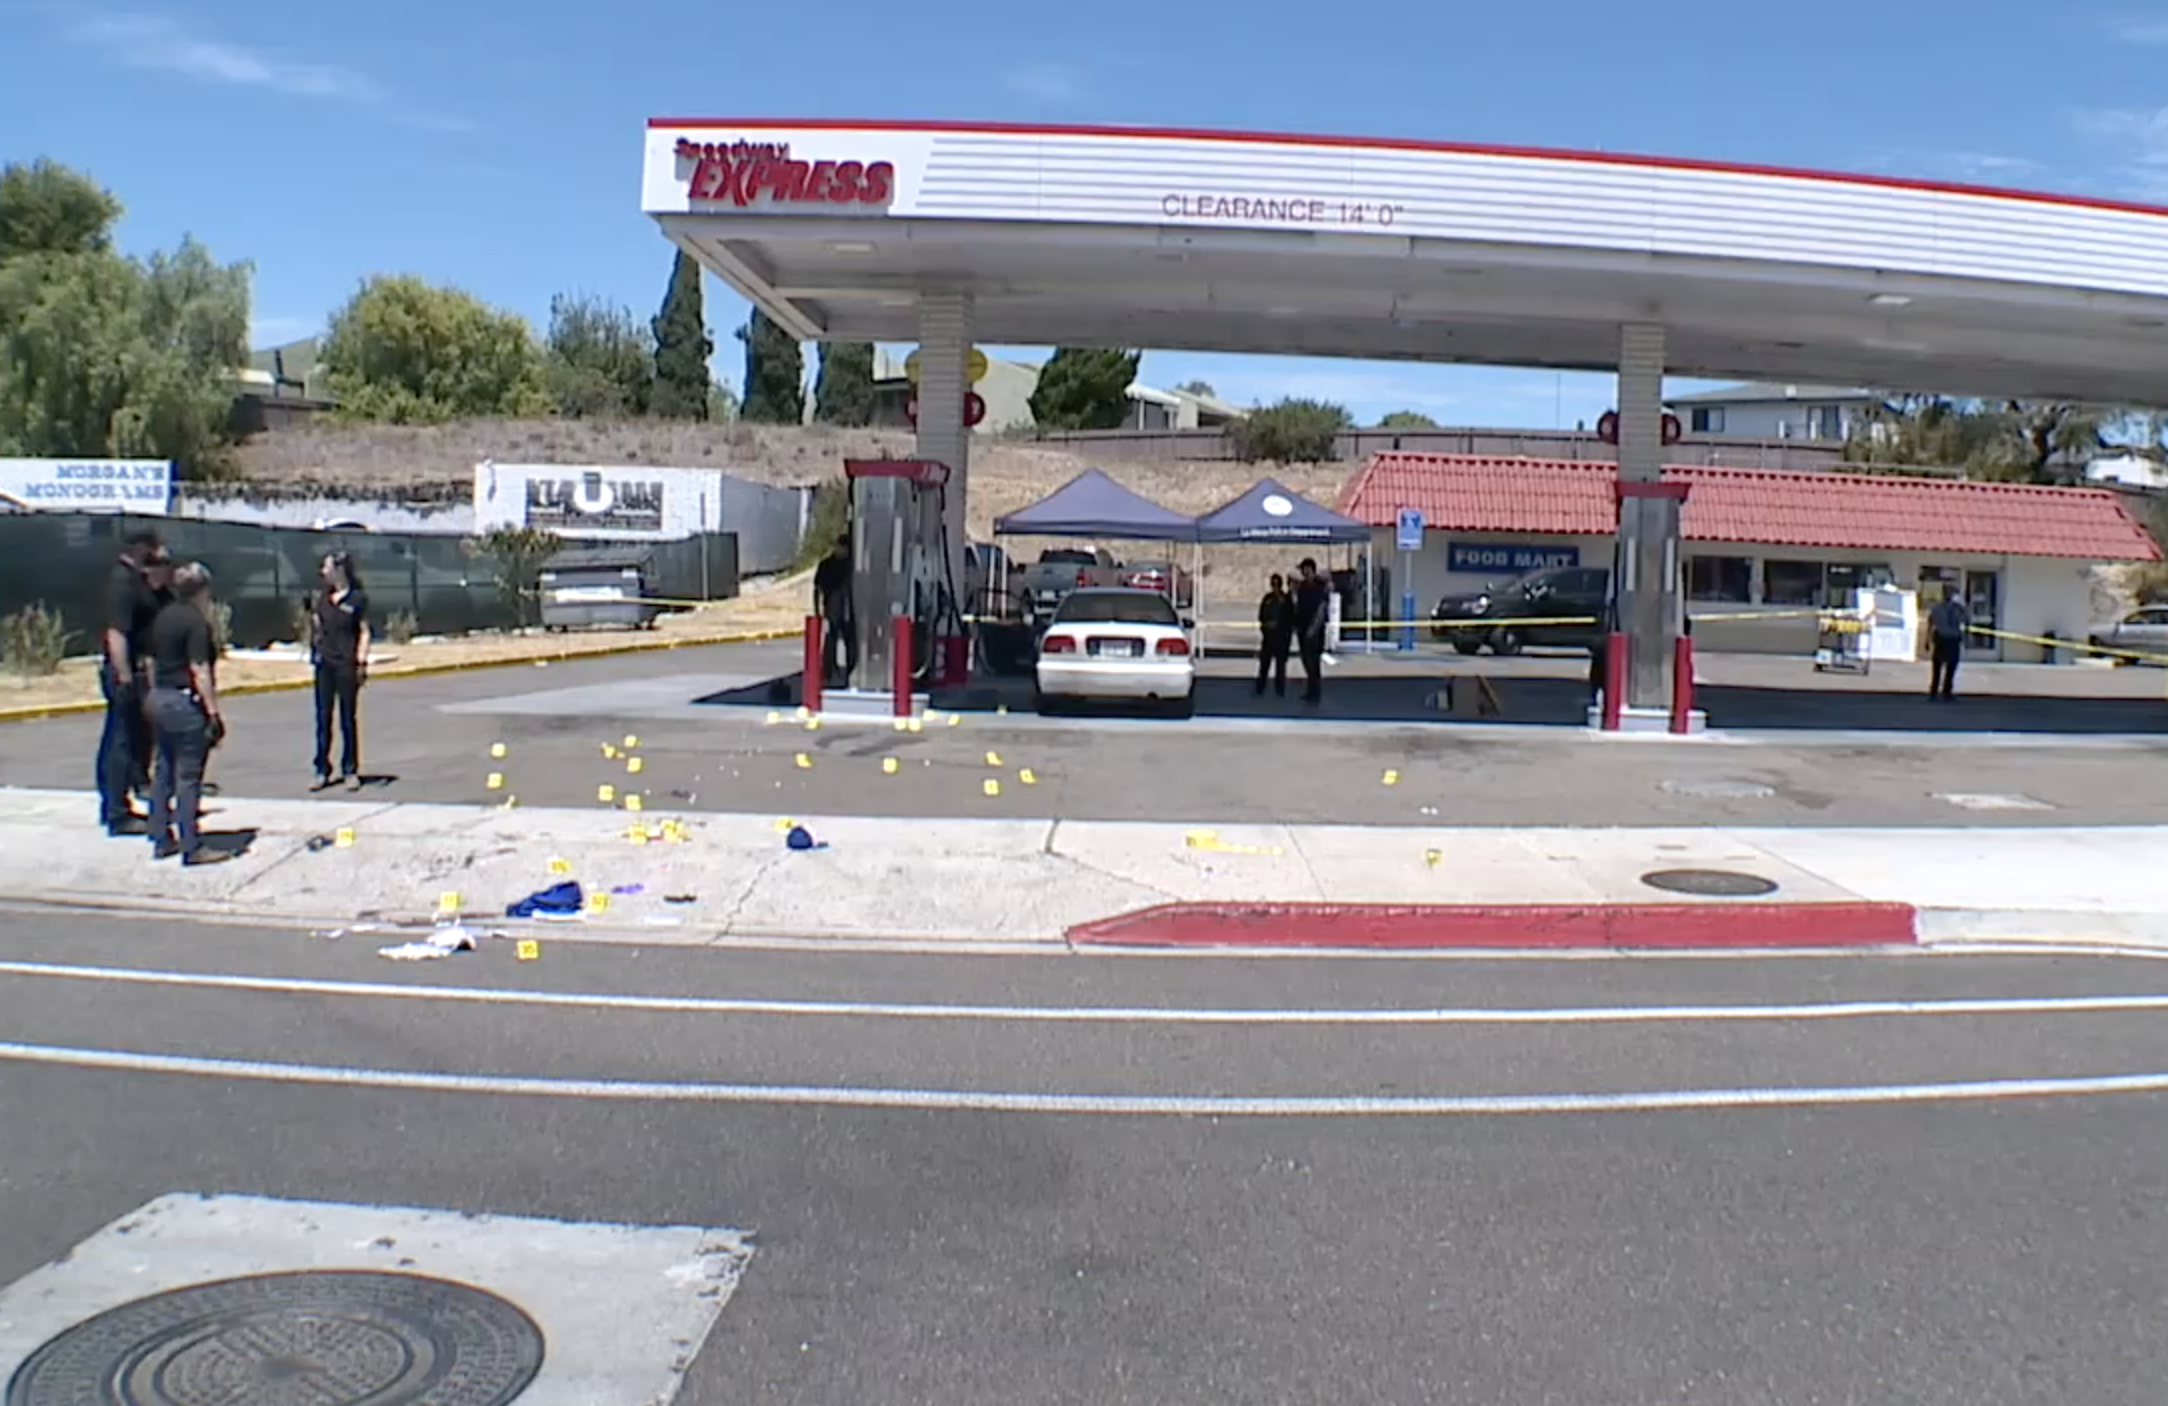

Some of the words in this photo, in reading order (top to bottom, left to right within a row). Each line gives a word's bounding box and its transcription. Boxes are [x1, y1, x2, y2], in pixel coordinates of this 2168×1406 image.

[688, 160, 894, 206] EXPRESS
[1162, 194, 1325, 223] CLEARANCE
[25, 483, 165, 499] MONOGRAMS
[1455, 551, 1508, 566] FOOD
[1514, 553, 1573, 568] MART
